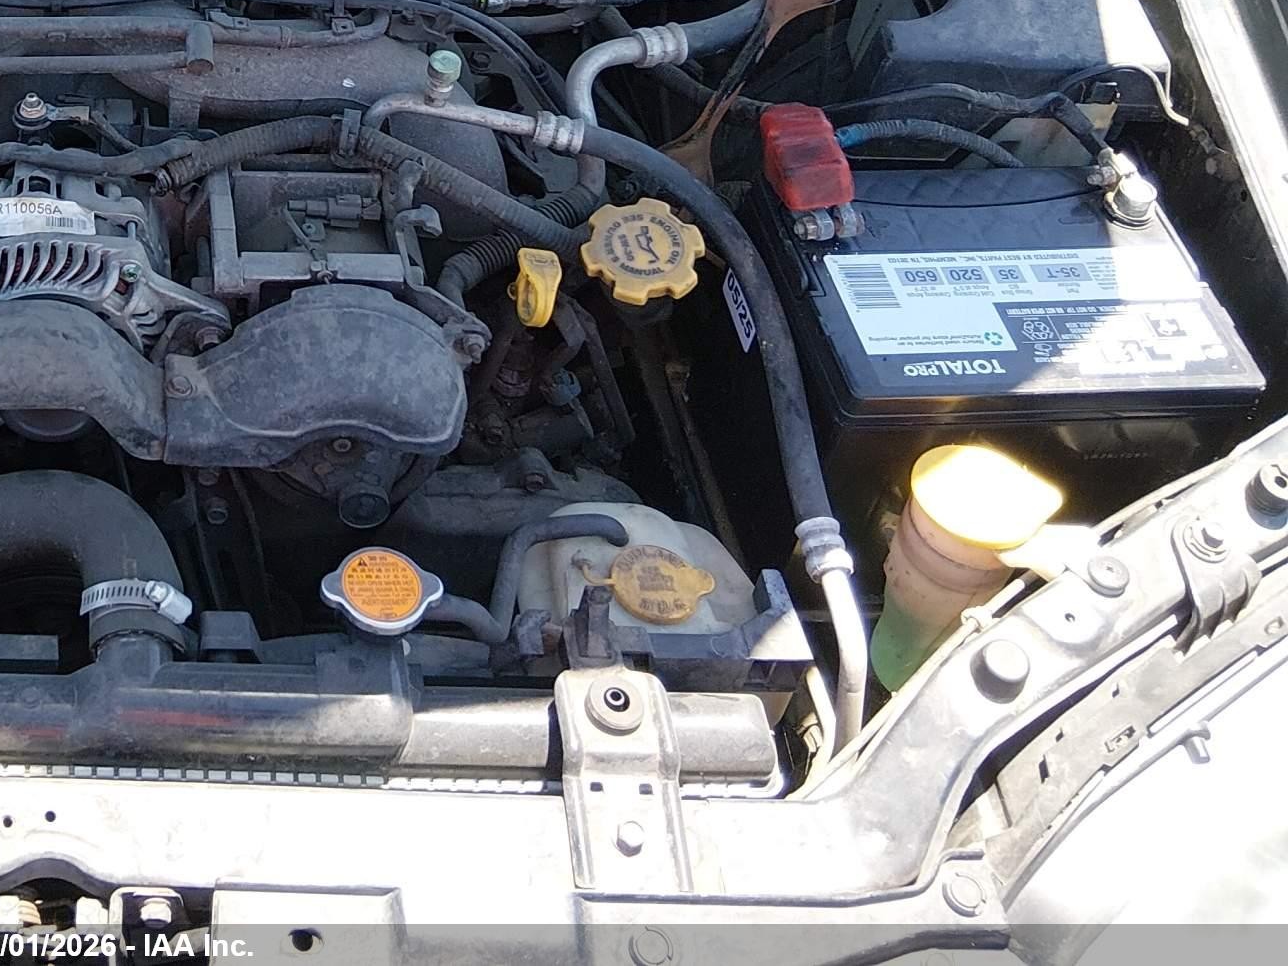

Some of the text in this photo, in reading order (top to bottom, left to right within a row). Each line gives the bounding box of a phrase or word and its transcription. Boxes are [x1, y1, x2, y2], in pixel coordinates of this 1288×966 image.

[649, 216, 681, 265] ENGINE OIL
[619, 262, 665, 276] MANUAL
[904, 269, 938, 283] 650
[949, 268, 983, 282] 520
[998, 267, 1019, 281] 35
[1046, 266, 1081, 279] 35-T
[903, 358, 1007, 377] TOTALPRO
